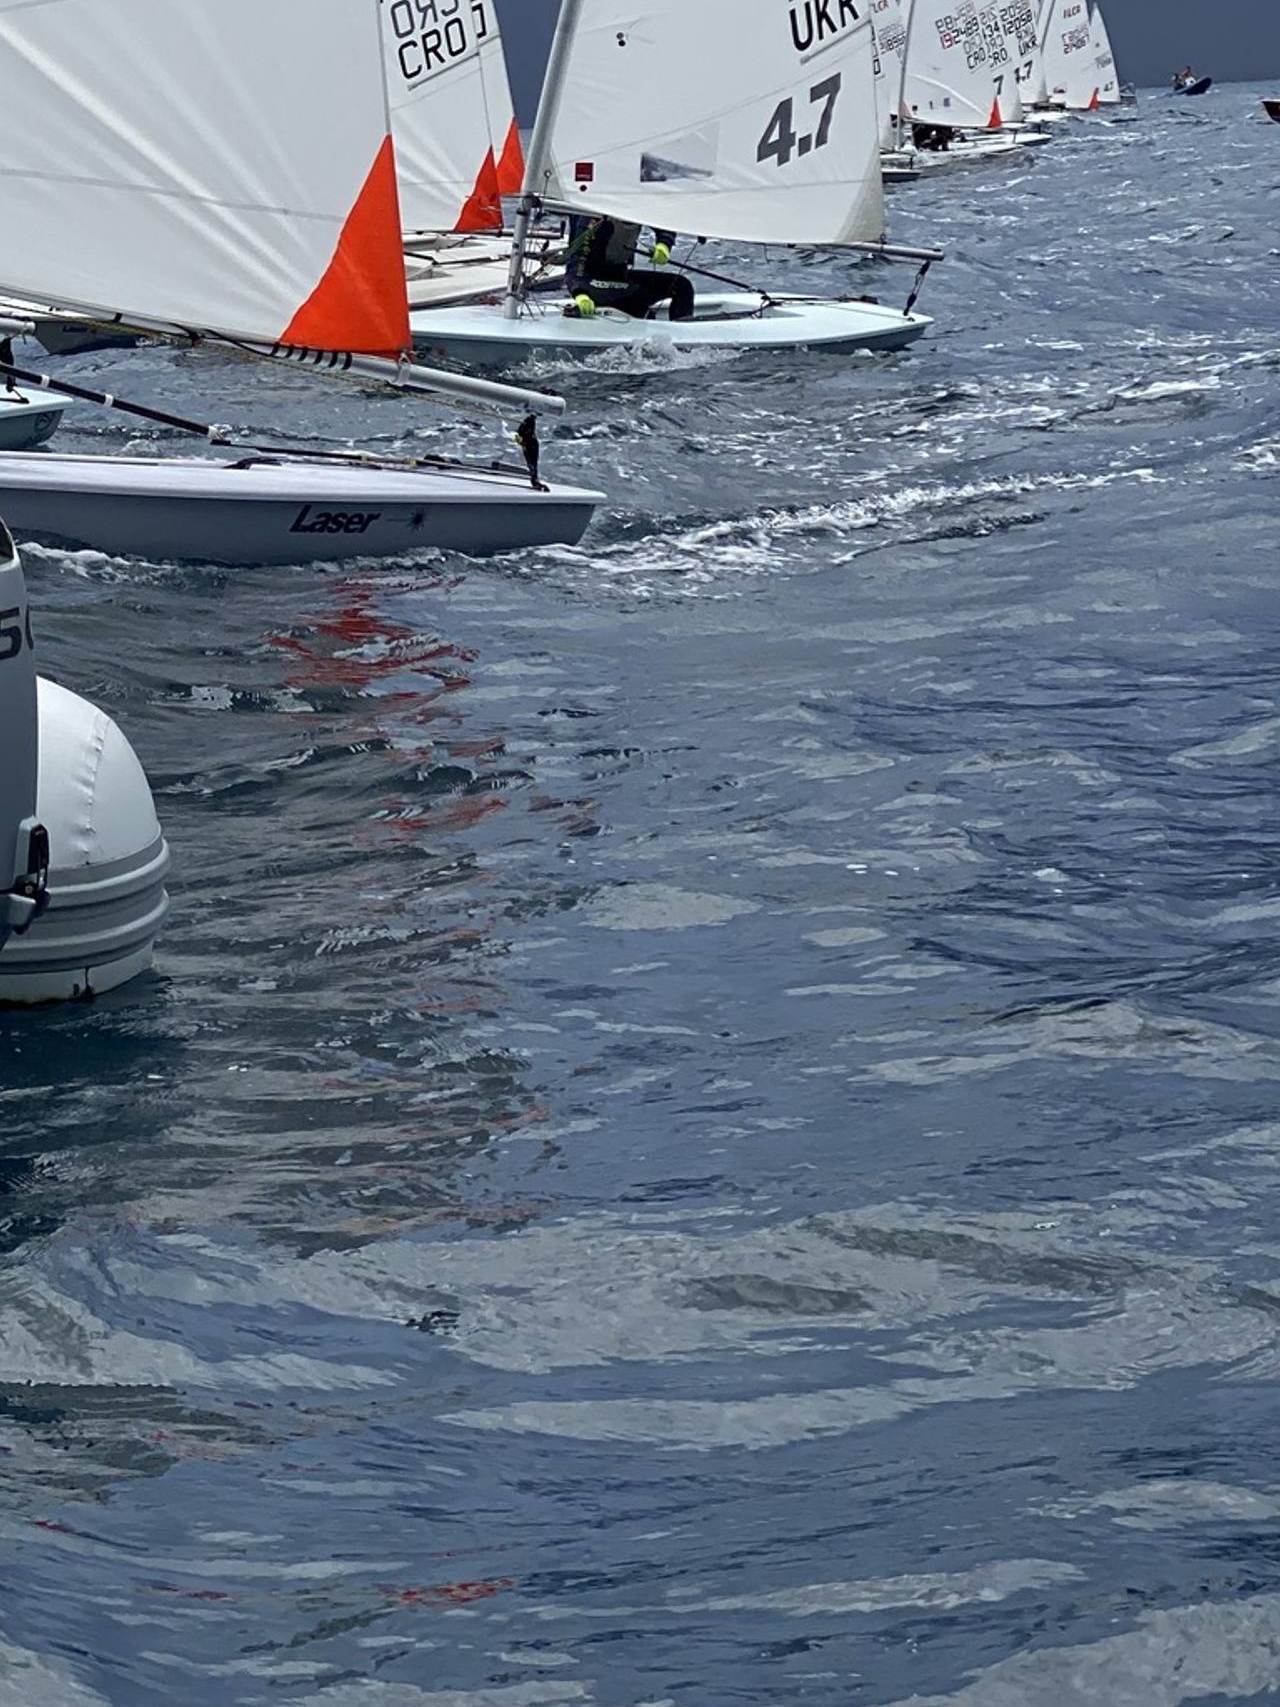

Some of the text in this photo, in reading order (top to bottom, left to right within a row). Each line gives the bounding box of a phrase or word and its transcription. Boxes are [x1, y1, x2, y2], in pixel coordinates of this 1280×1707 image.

[398, 17, 467, 80] CRO
[757, 72, 842, 167] 4.7
[289, 504, 382, 534] Laser
